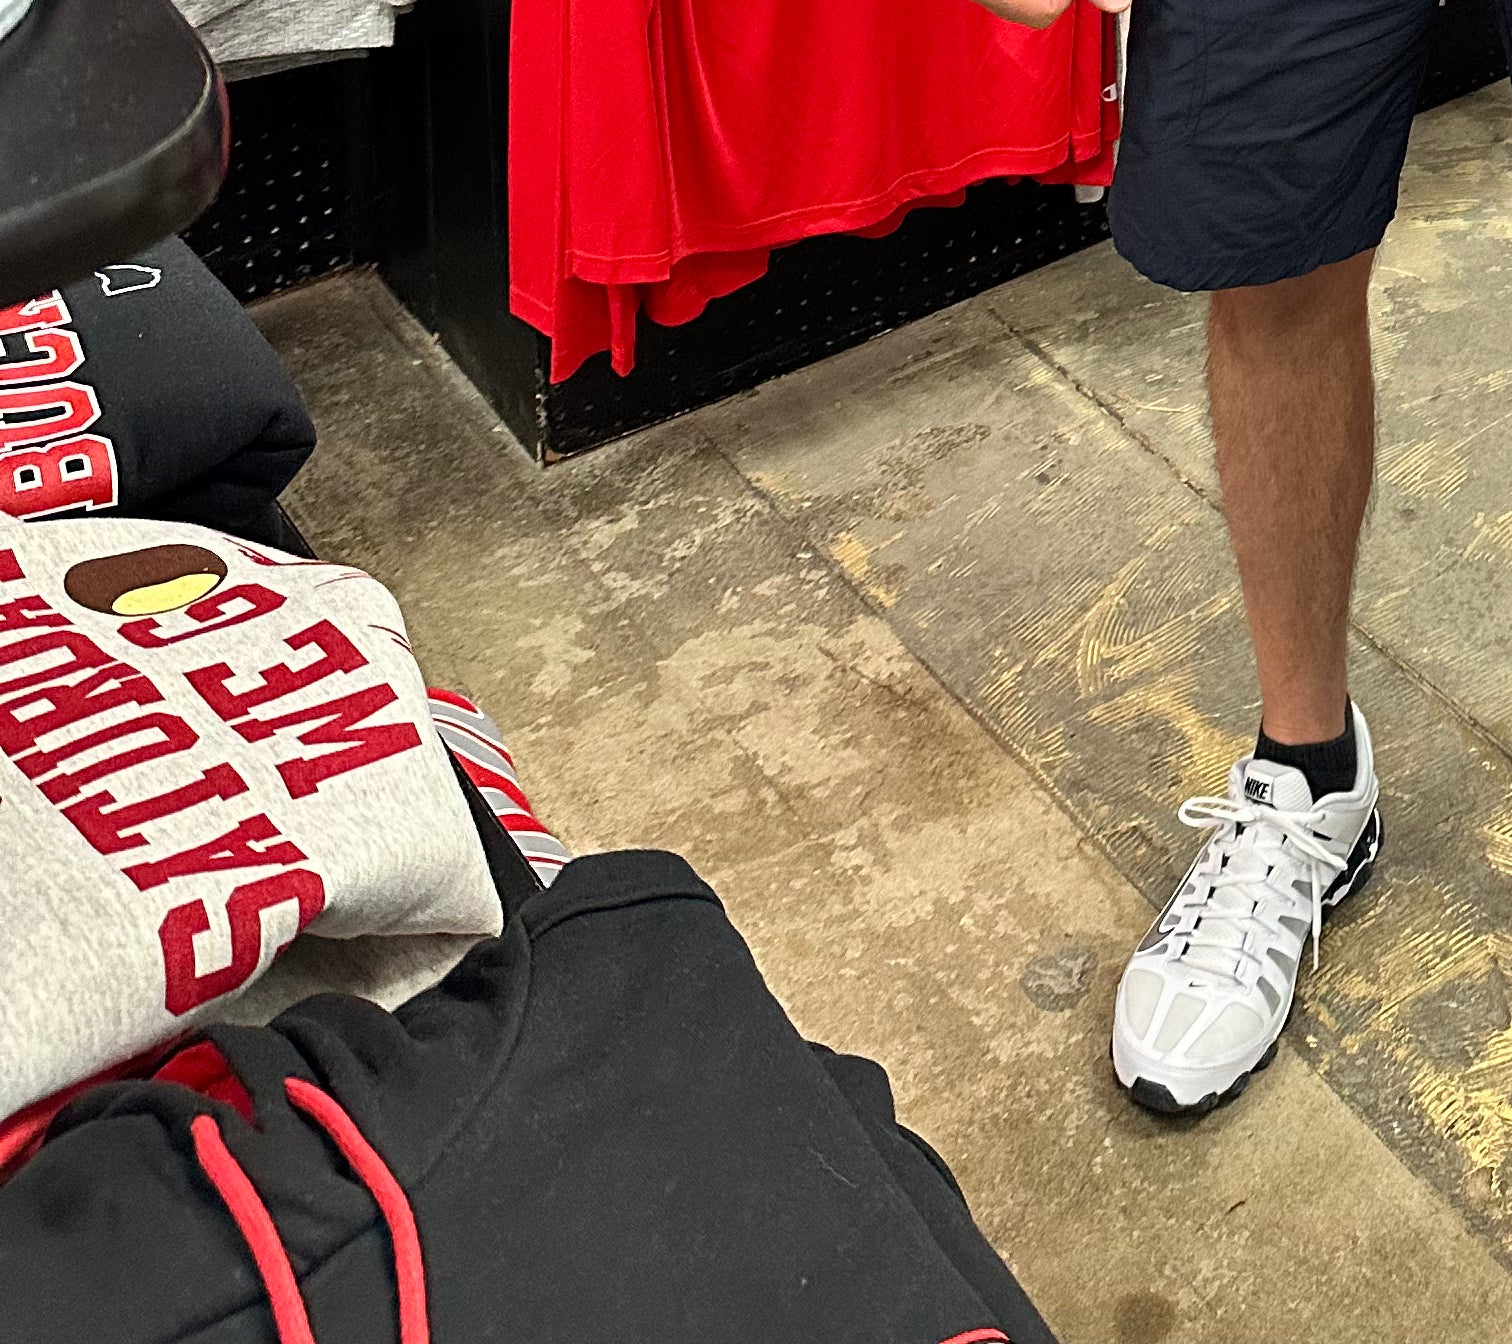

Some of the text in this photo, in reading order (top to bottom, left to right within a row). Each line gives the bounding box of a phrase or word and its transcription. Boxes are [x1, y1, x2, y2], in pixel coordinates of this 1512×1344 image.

[0, 547, 327, 1018] SATURDA
[183, 618, 424, 801] WE
[1244, 776, 1270, 801] NIKE
